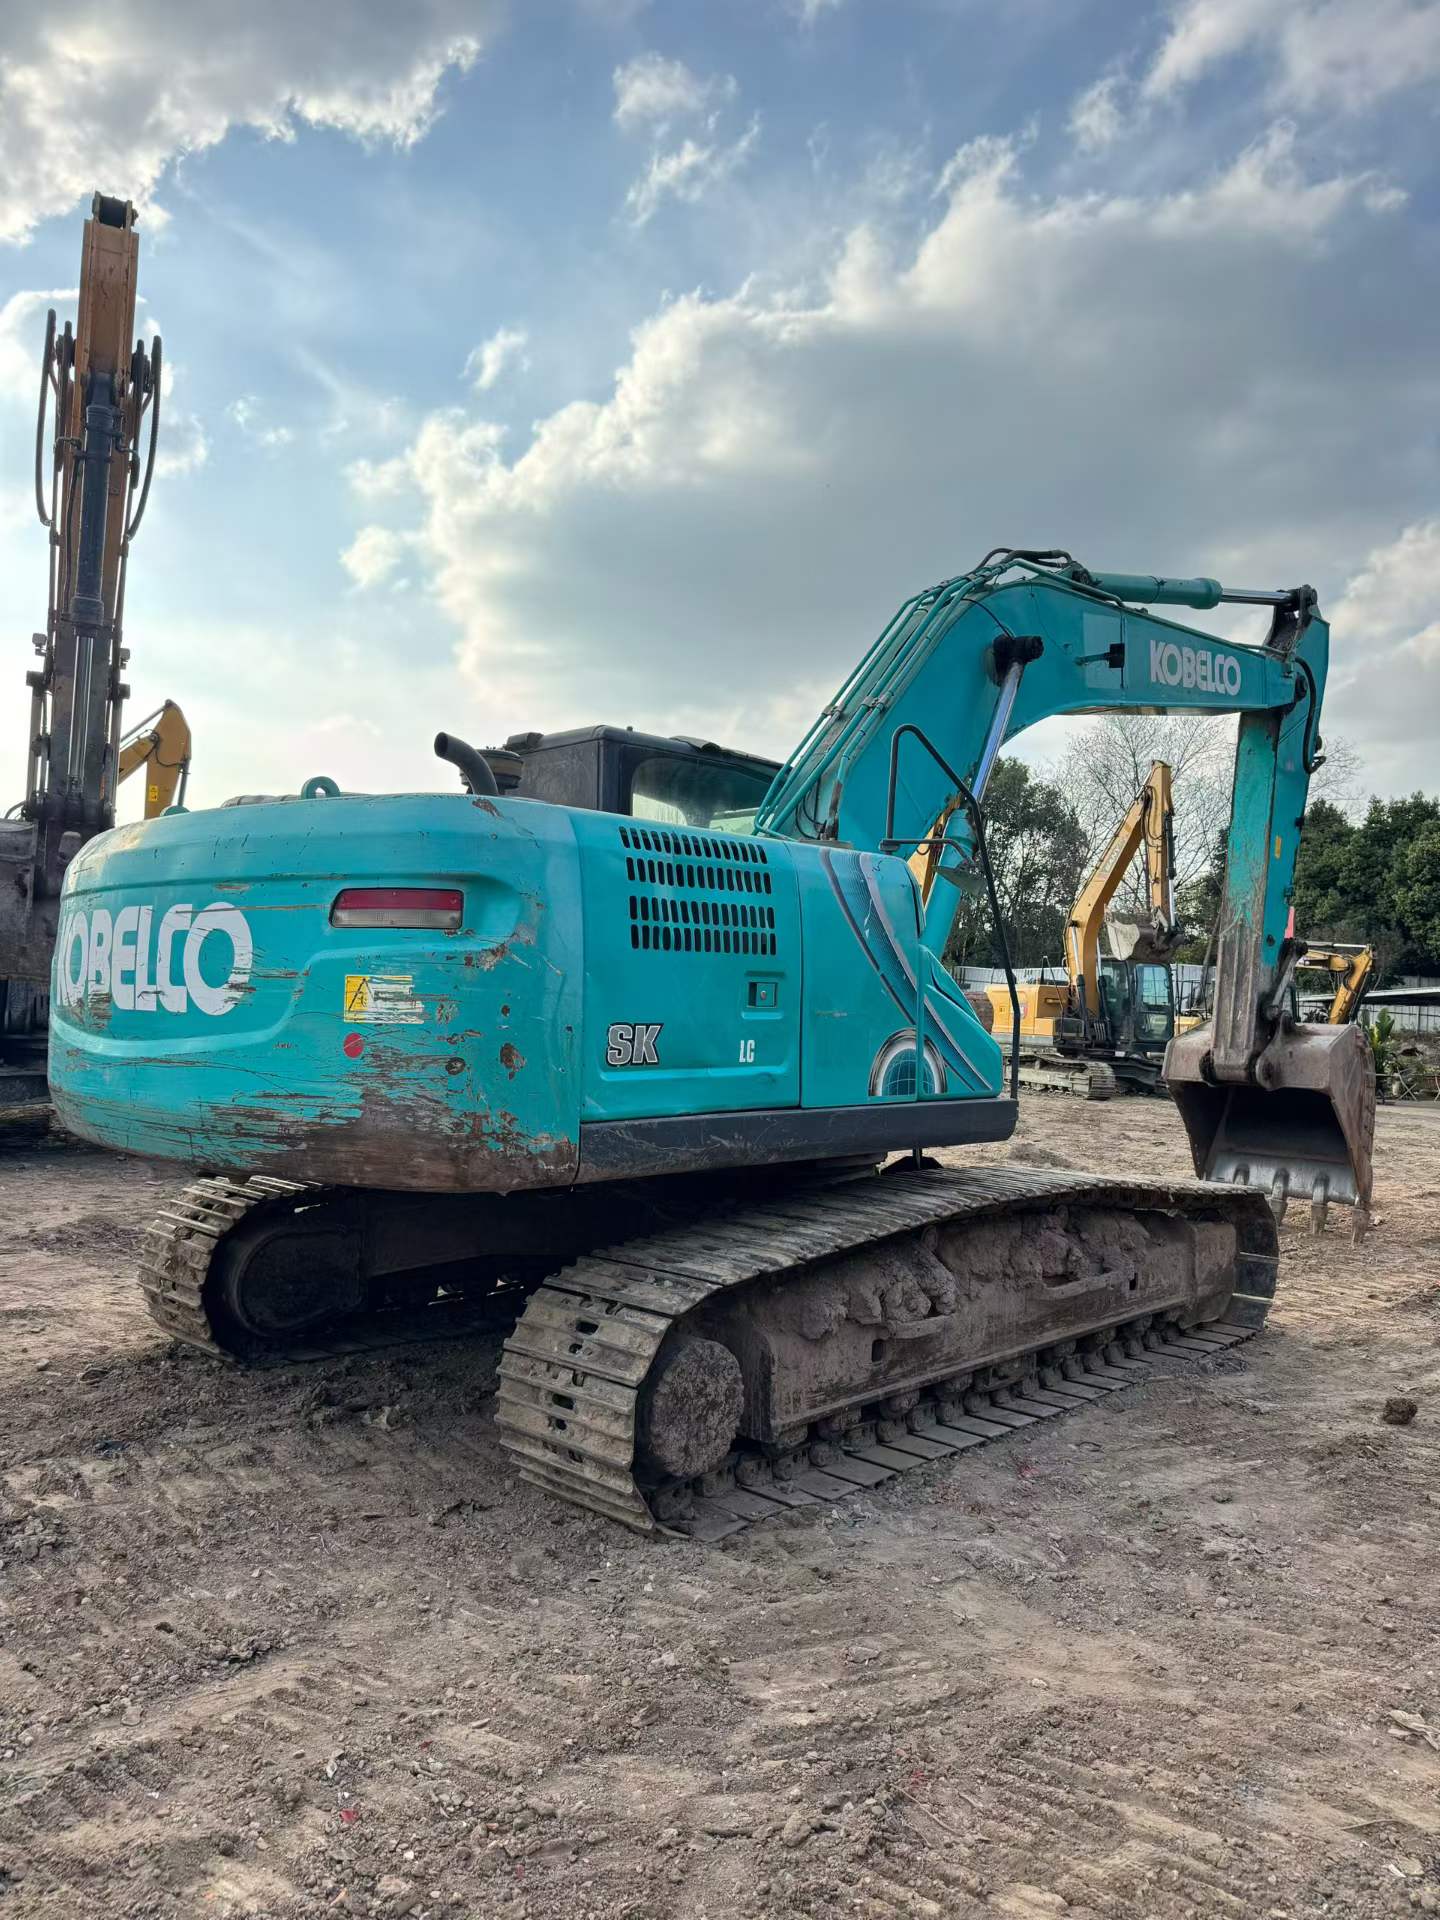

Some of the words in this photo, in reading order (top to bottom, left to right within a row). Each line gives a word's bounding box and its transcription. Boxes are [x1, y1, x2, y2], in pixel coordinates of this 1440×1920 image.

[1150, 640, 1241, 695] KOBELCO
[57, 902, 253, 1015] KOBELCO
[606, 1023, 662, 1066] SK
[739, 1039, 755, 1063] LC
